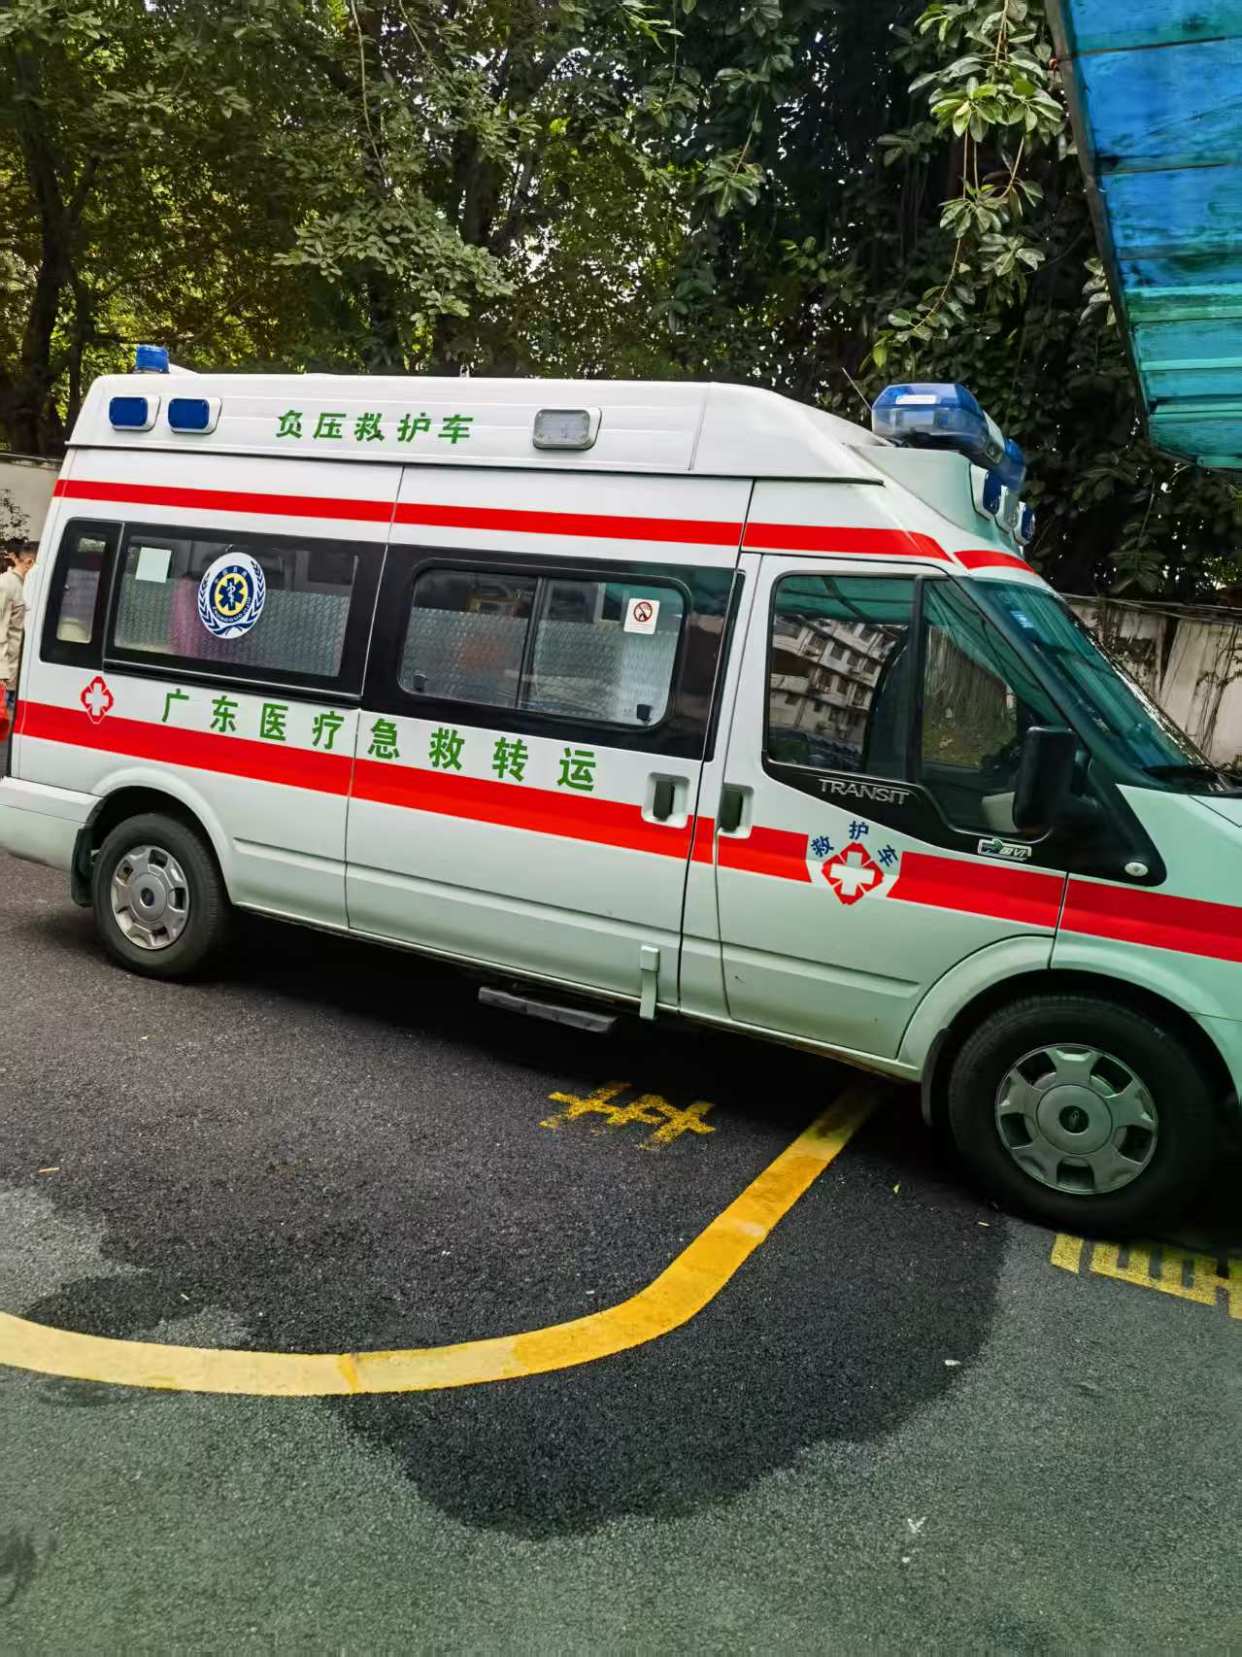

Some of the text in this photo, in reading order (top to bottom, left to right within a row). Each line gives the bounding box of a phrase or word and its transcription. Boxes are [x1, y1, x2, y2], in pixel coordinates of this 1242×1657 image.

[276, 410, 473, 444] 负压救护车
[161, 689, 597, 791] 广东医疗急救转运
[818, 778, 910, 805] TRANSIT
[811, 820, 898, 868] 救护车
